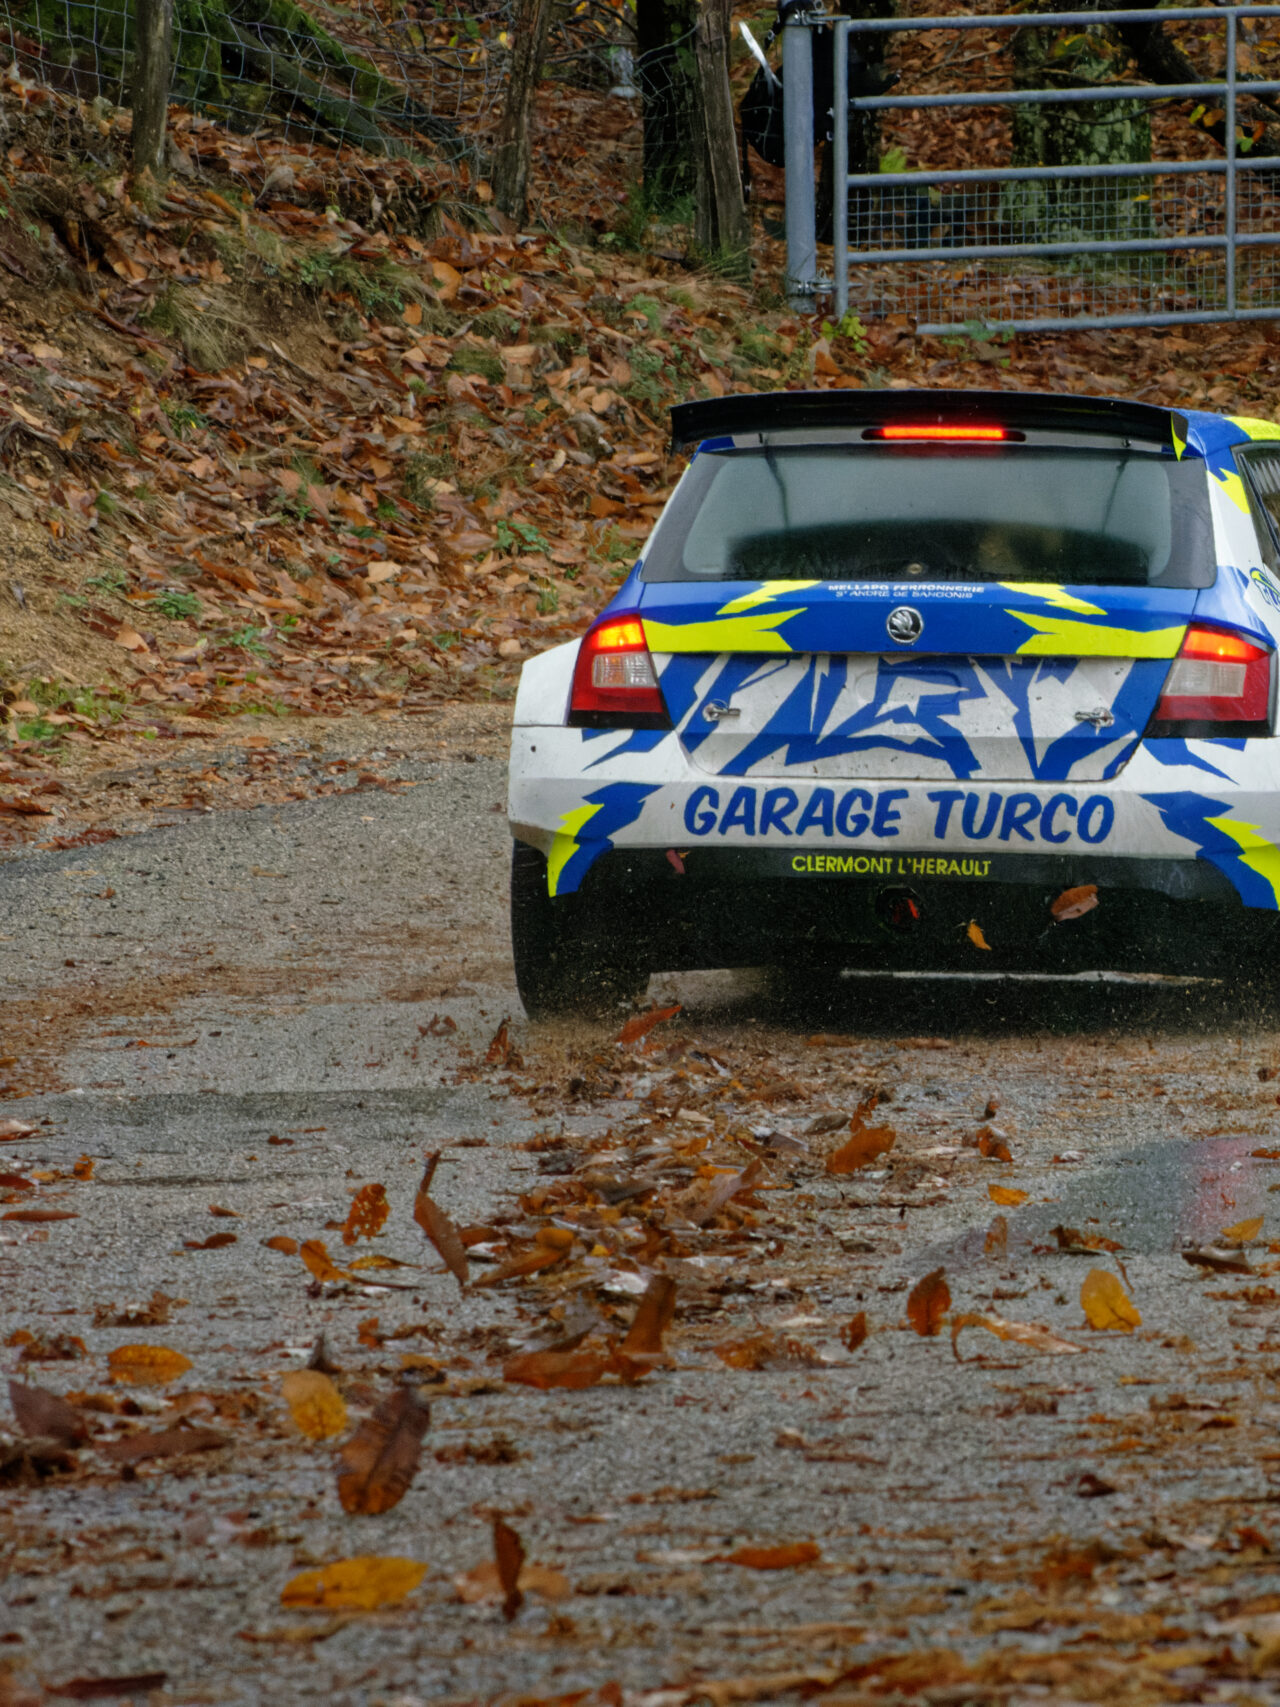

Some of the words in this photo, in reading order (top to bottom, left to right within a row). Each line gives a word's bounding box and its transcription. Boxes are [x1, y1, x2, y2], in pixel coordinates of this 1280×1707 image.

[683, 785, 909, 838] GARAGE
[927, 789, 1115, 844] TURCO
[791, 855, 893, 875] CLERMONT
[897, 858, 992, 877] L'HERAULT
